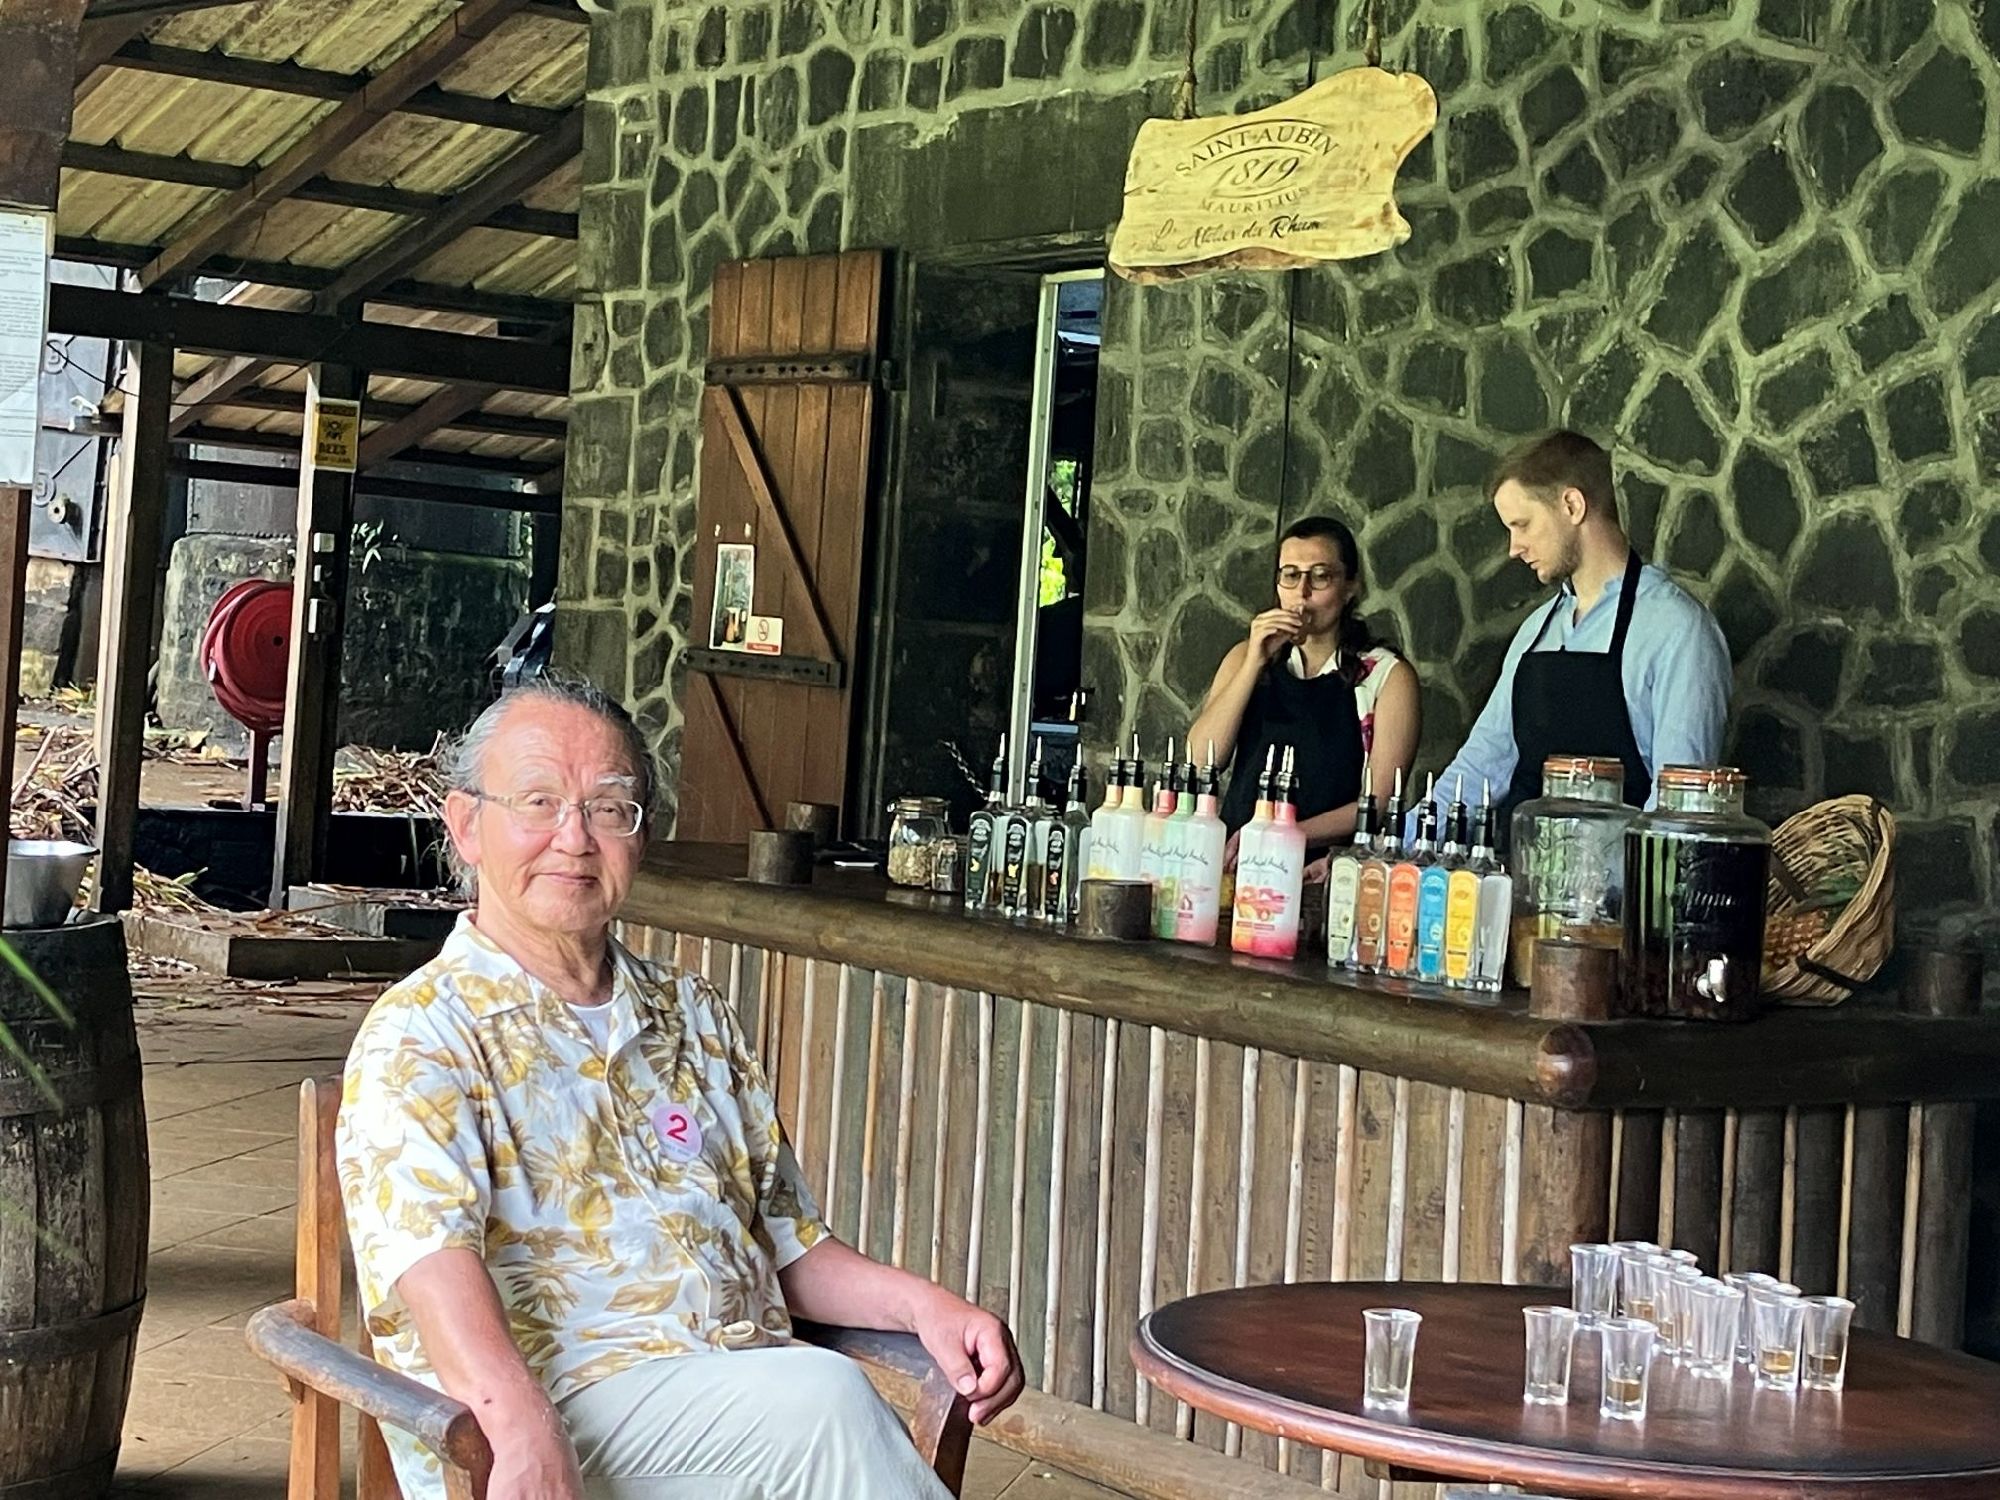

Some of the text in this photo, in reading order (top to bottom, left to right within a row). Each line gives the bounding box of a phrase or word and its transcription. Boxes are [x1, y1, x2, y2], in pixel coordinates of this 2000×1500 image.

[1213, 156, 1301, 189] 1819
[1201, 187, 1311, 214] MAURITIUS
[1241, 220, 1263, 239] du
[1269, 213, 1322, 239] Rhum
[667, 1113, 688, 1143] 2
